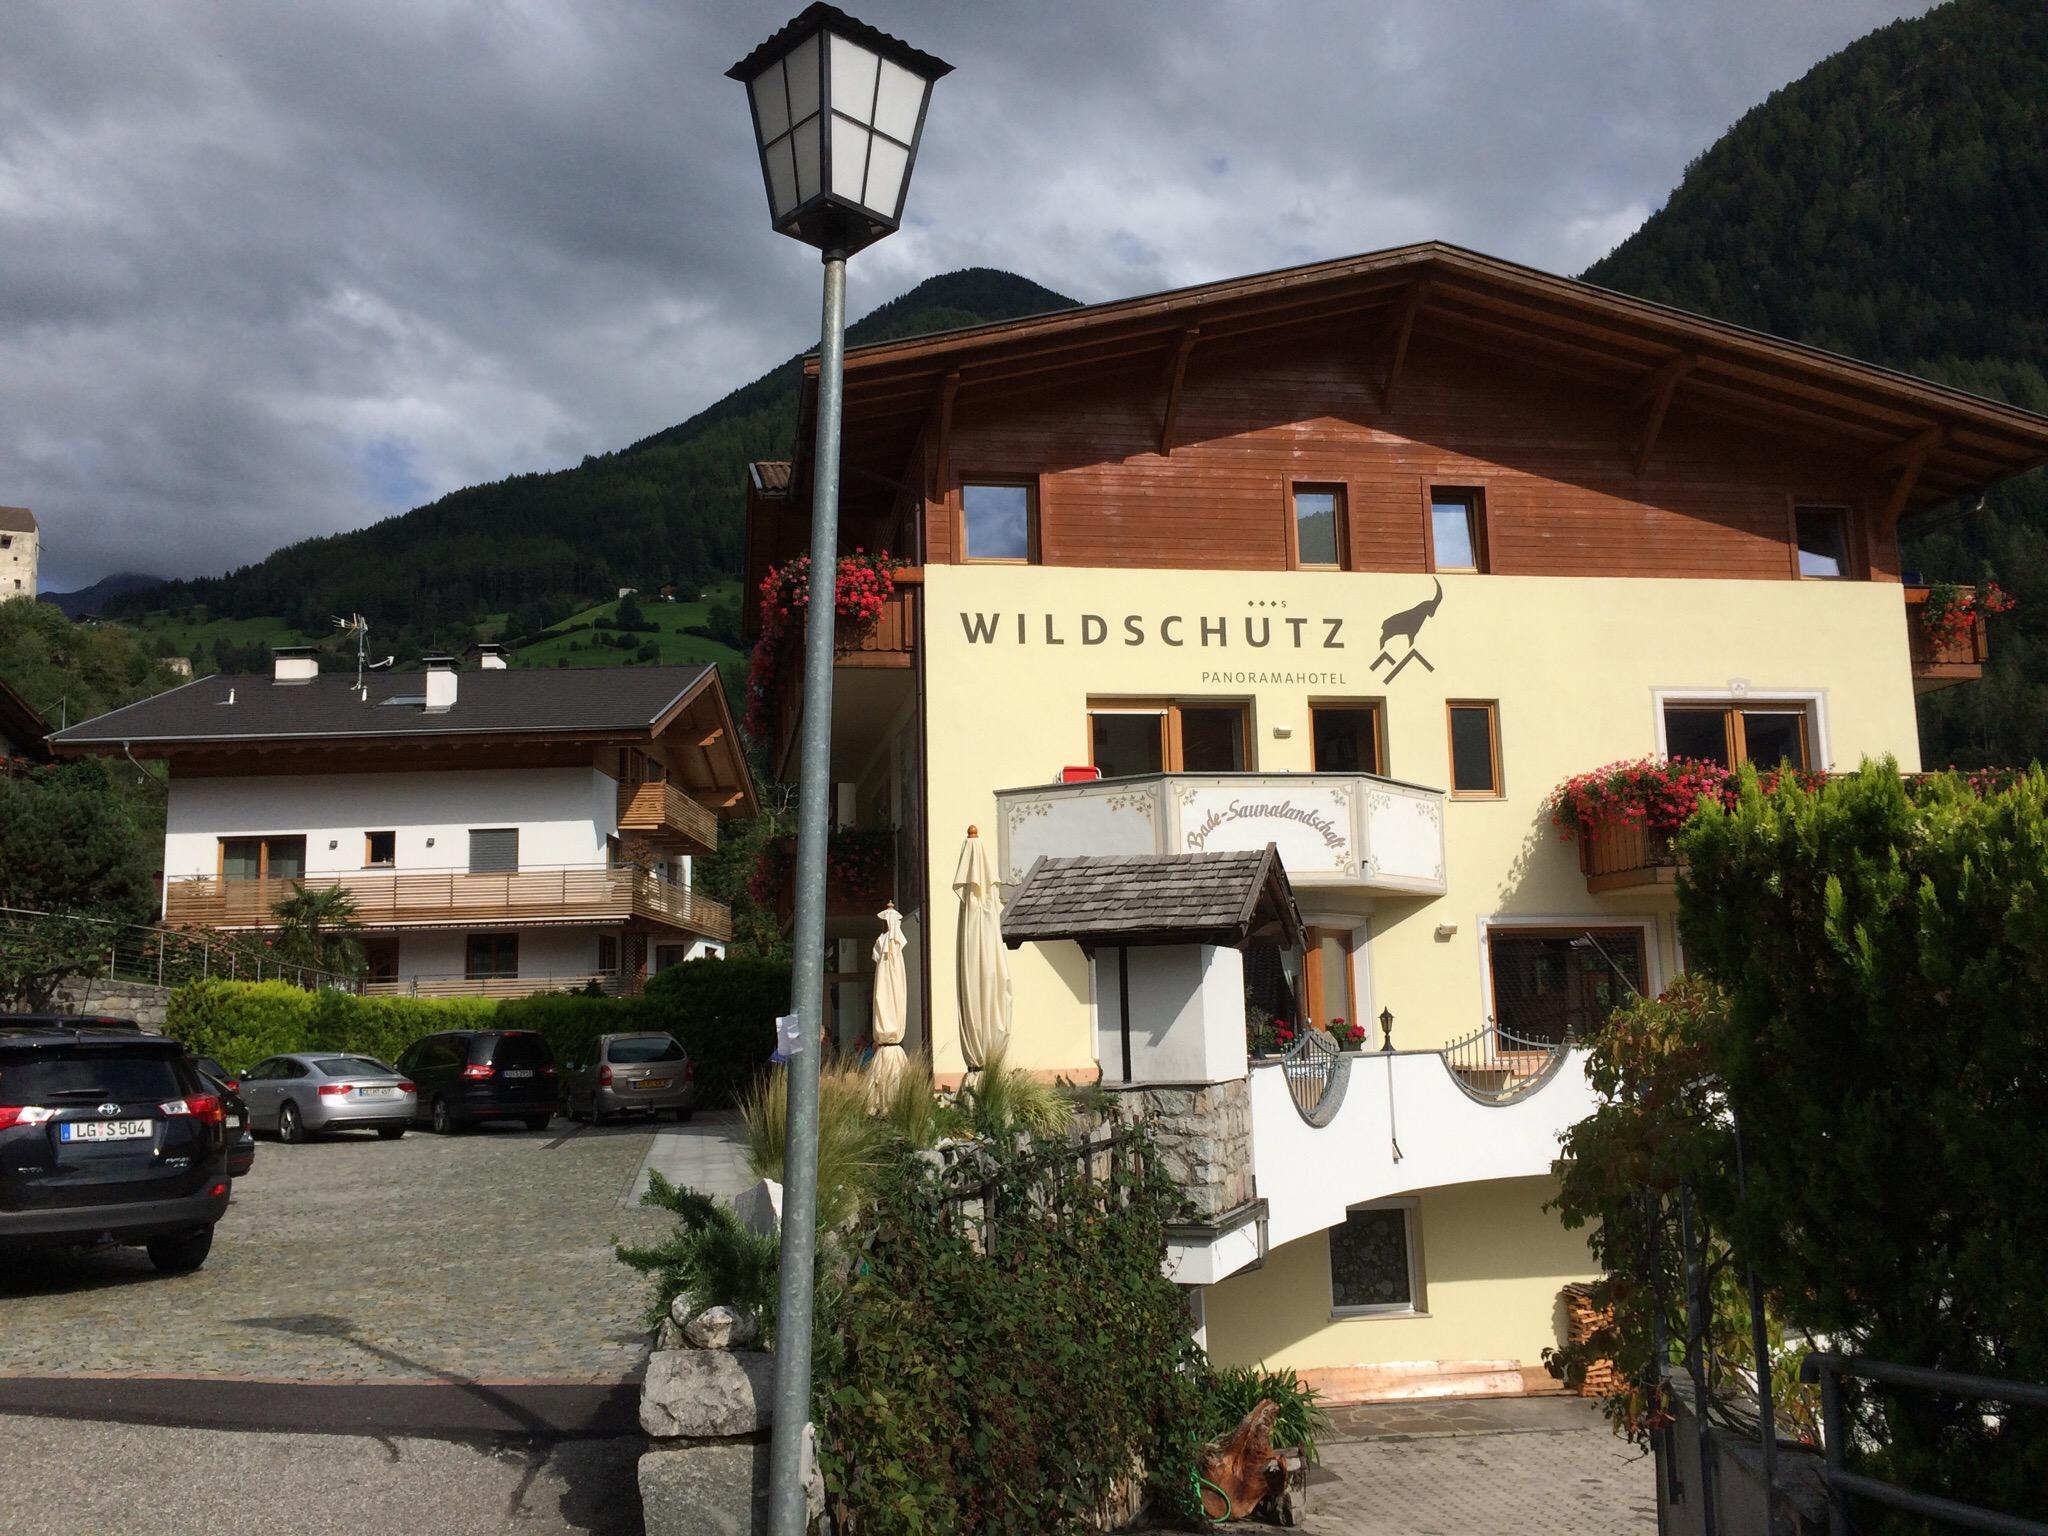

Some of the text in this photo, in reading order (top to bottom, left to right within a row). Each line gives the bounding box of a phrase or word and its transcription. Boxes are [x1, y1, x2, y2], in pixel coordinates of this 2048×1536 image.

[1202, 671, 1347, 685] PANORAMAHOTEL
[1187, 799, 1347, 851] Bade-Saunalandschaft
[76, 1121, 145, 1138] LG S 504
